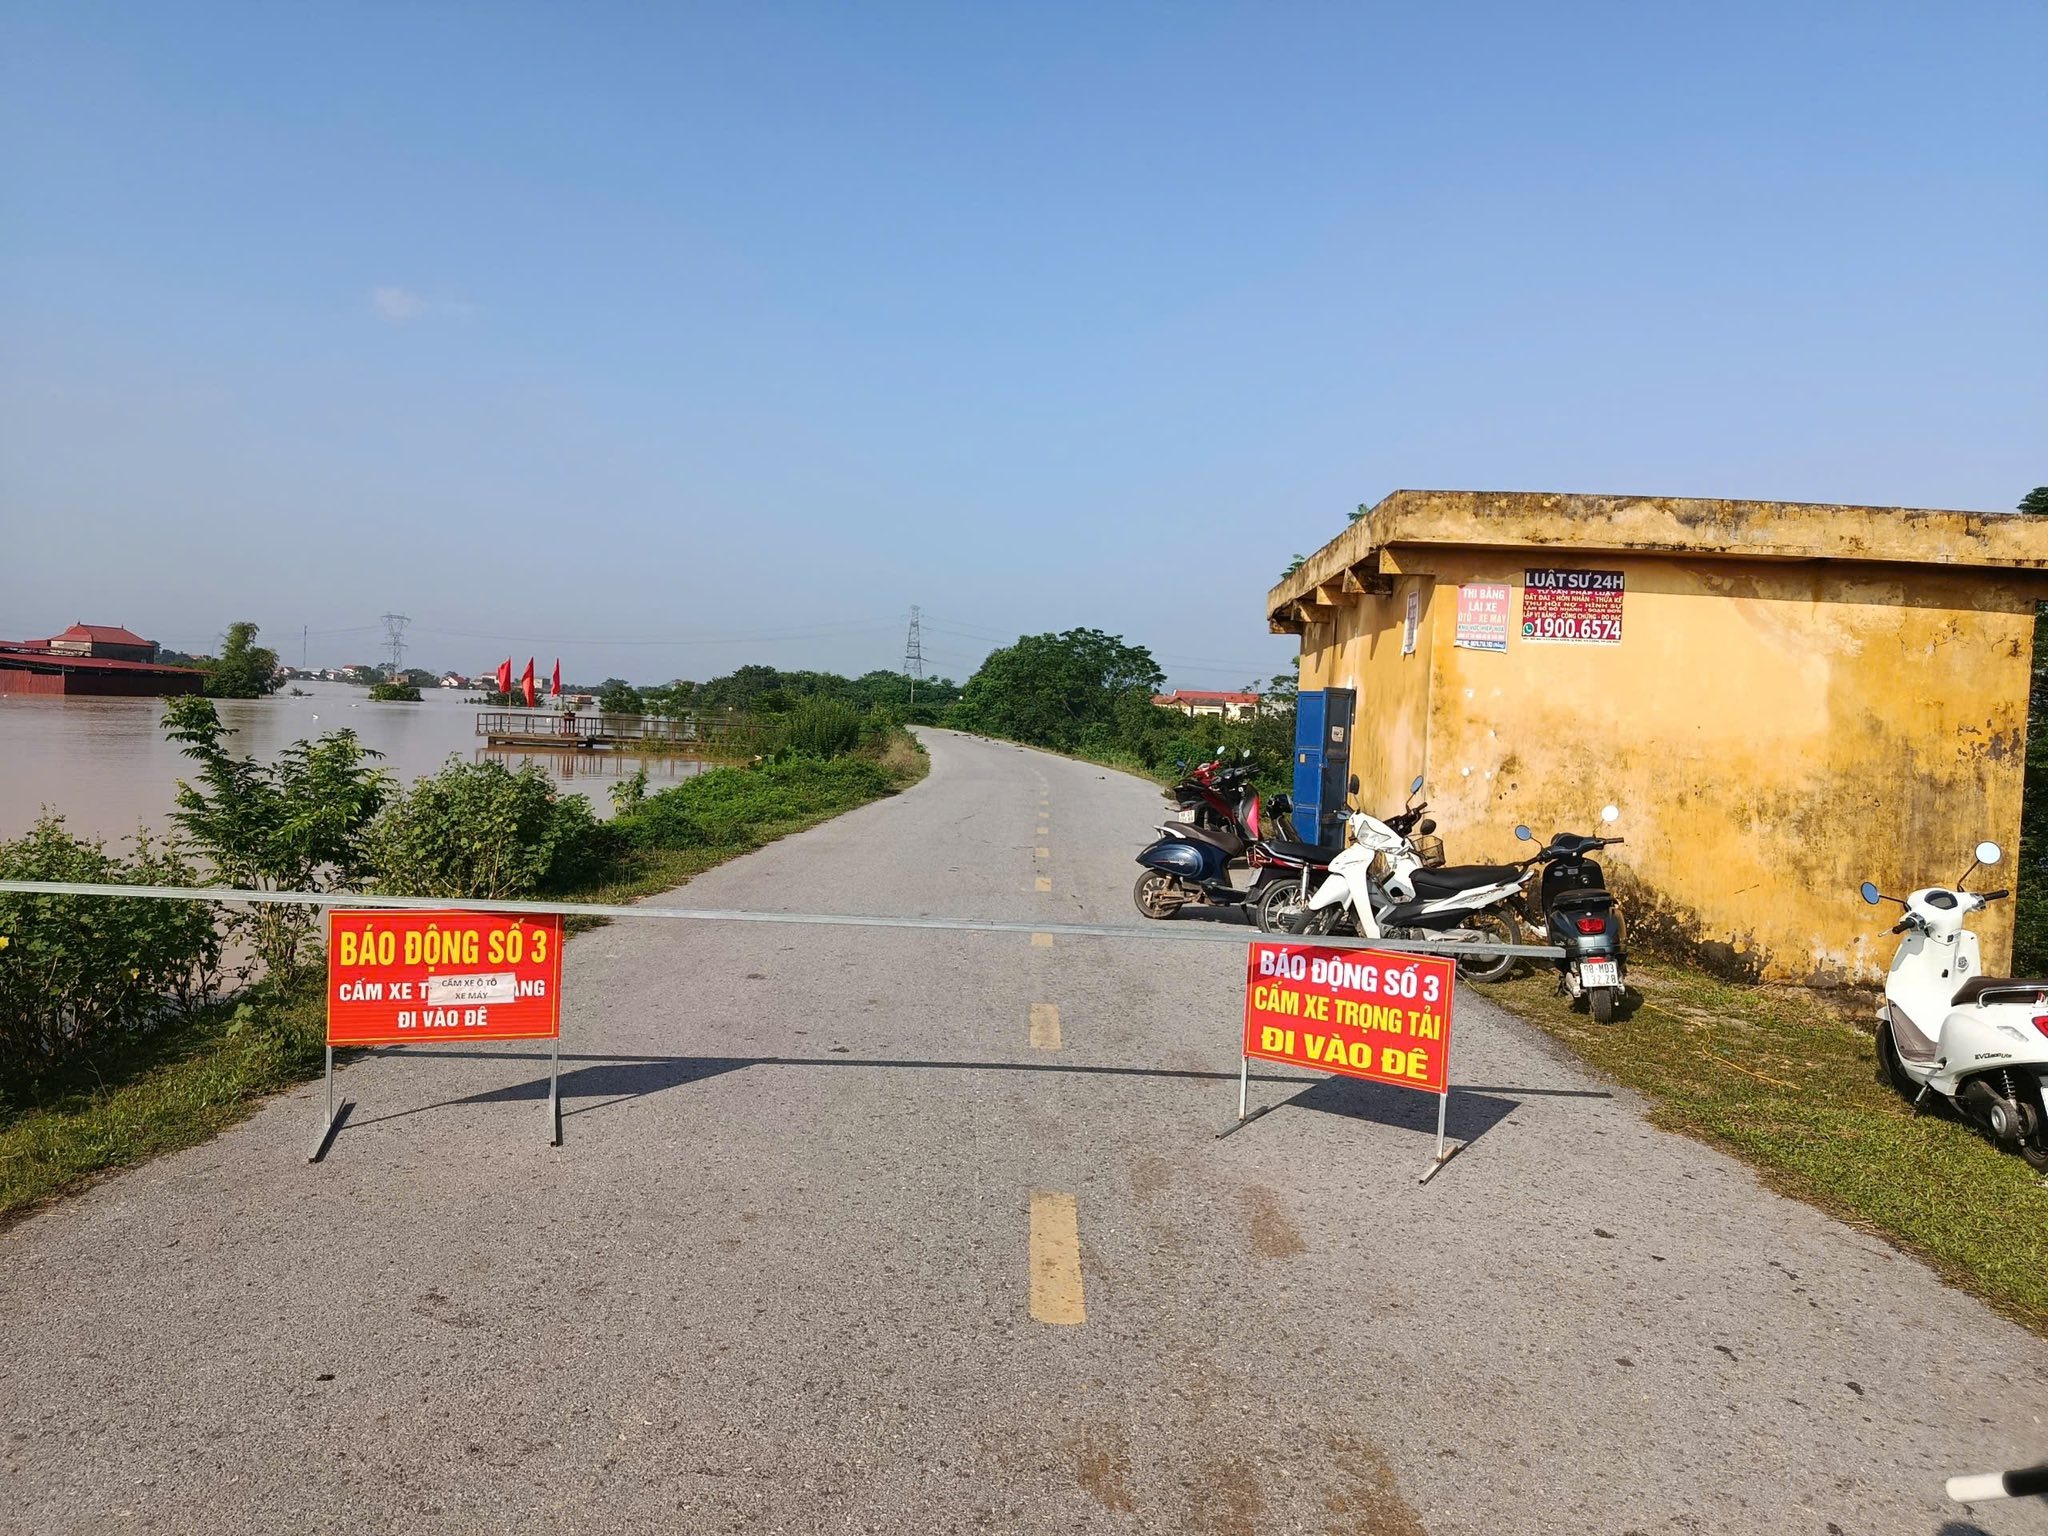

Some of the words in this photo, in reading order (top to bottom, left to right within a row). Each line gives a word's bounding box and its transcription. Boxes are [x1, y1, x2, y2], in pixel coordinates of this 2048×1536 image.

[1526, 569, 1566, 589] LUẬT
[1568, 572, 1592, 589] SƯ
[1593, 575, 1624, 590] 24H
[1463, 588, 1477, 599] THI
[1486, 602, 1498, 612] XE
[1534, 618, 1621, 639] 1900.6574
[340, 923, 396, 966] BÁO
[404, 923, 479, 972] ĐỘNG
[488, 918, 525, 964] SỐ
[531, 930, 547, 964] 3
[441, 977, 462, 987] CẤM
[464, 979, 476, 987] XE
[477, 978, 484, 987] Ô
[486, 977, 497, 986] TÔ
[1260, 947, 1307, 981] BÁO
[1311, 955, 1378, 993] ĐỘNG
[1383, 963, 1420, 999] SỐ
[1423, 975, 1439, 1002] 3
[339, 977, 383, 1001] CẤM
[388, 982, 412, 1000] XE
[455, 992, 465, 1000] XE
[468, 990, 488, 1000] MÁY
[397, 1011, 417, 1028] ĐI
[422, 1007, 459, 1028] VÀO
[464, 1005, 488, 1027] ĐÊ
[1254, 980, 1300, 1016] CẤM
[1303, 993, 1330, 1022] XE
[1334, 998, 1403, 1034] TRỌNG
[1408, 1004, 1441, 1041] TẢI
[1261, 1025, 1295, 1056] ĐI
[1303, 1032, 1373, 1069] VÀO
[1381, 1047, 1428, 1081] ĐÊ
